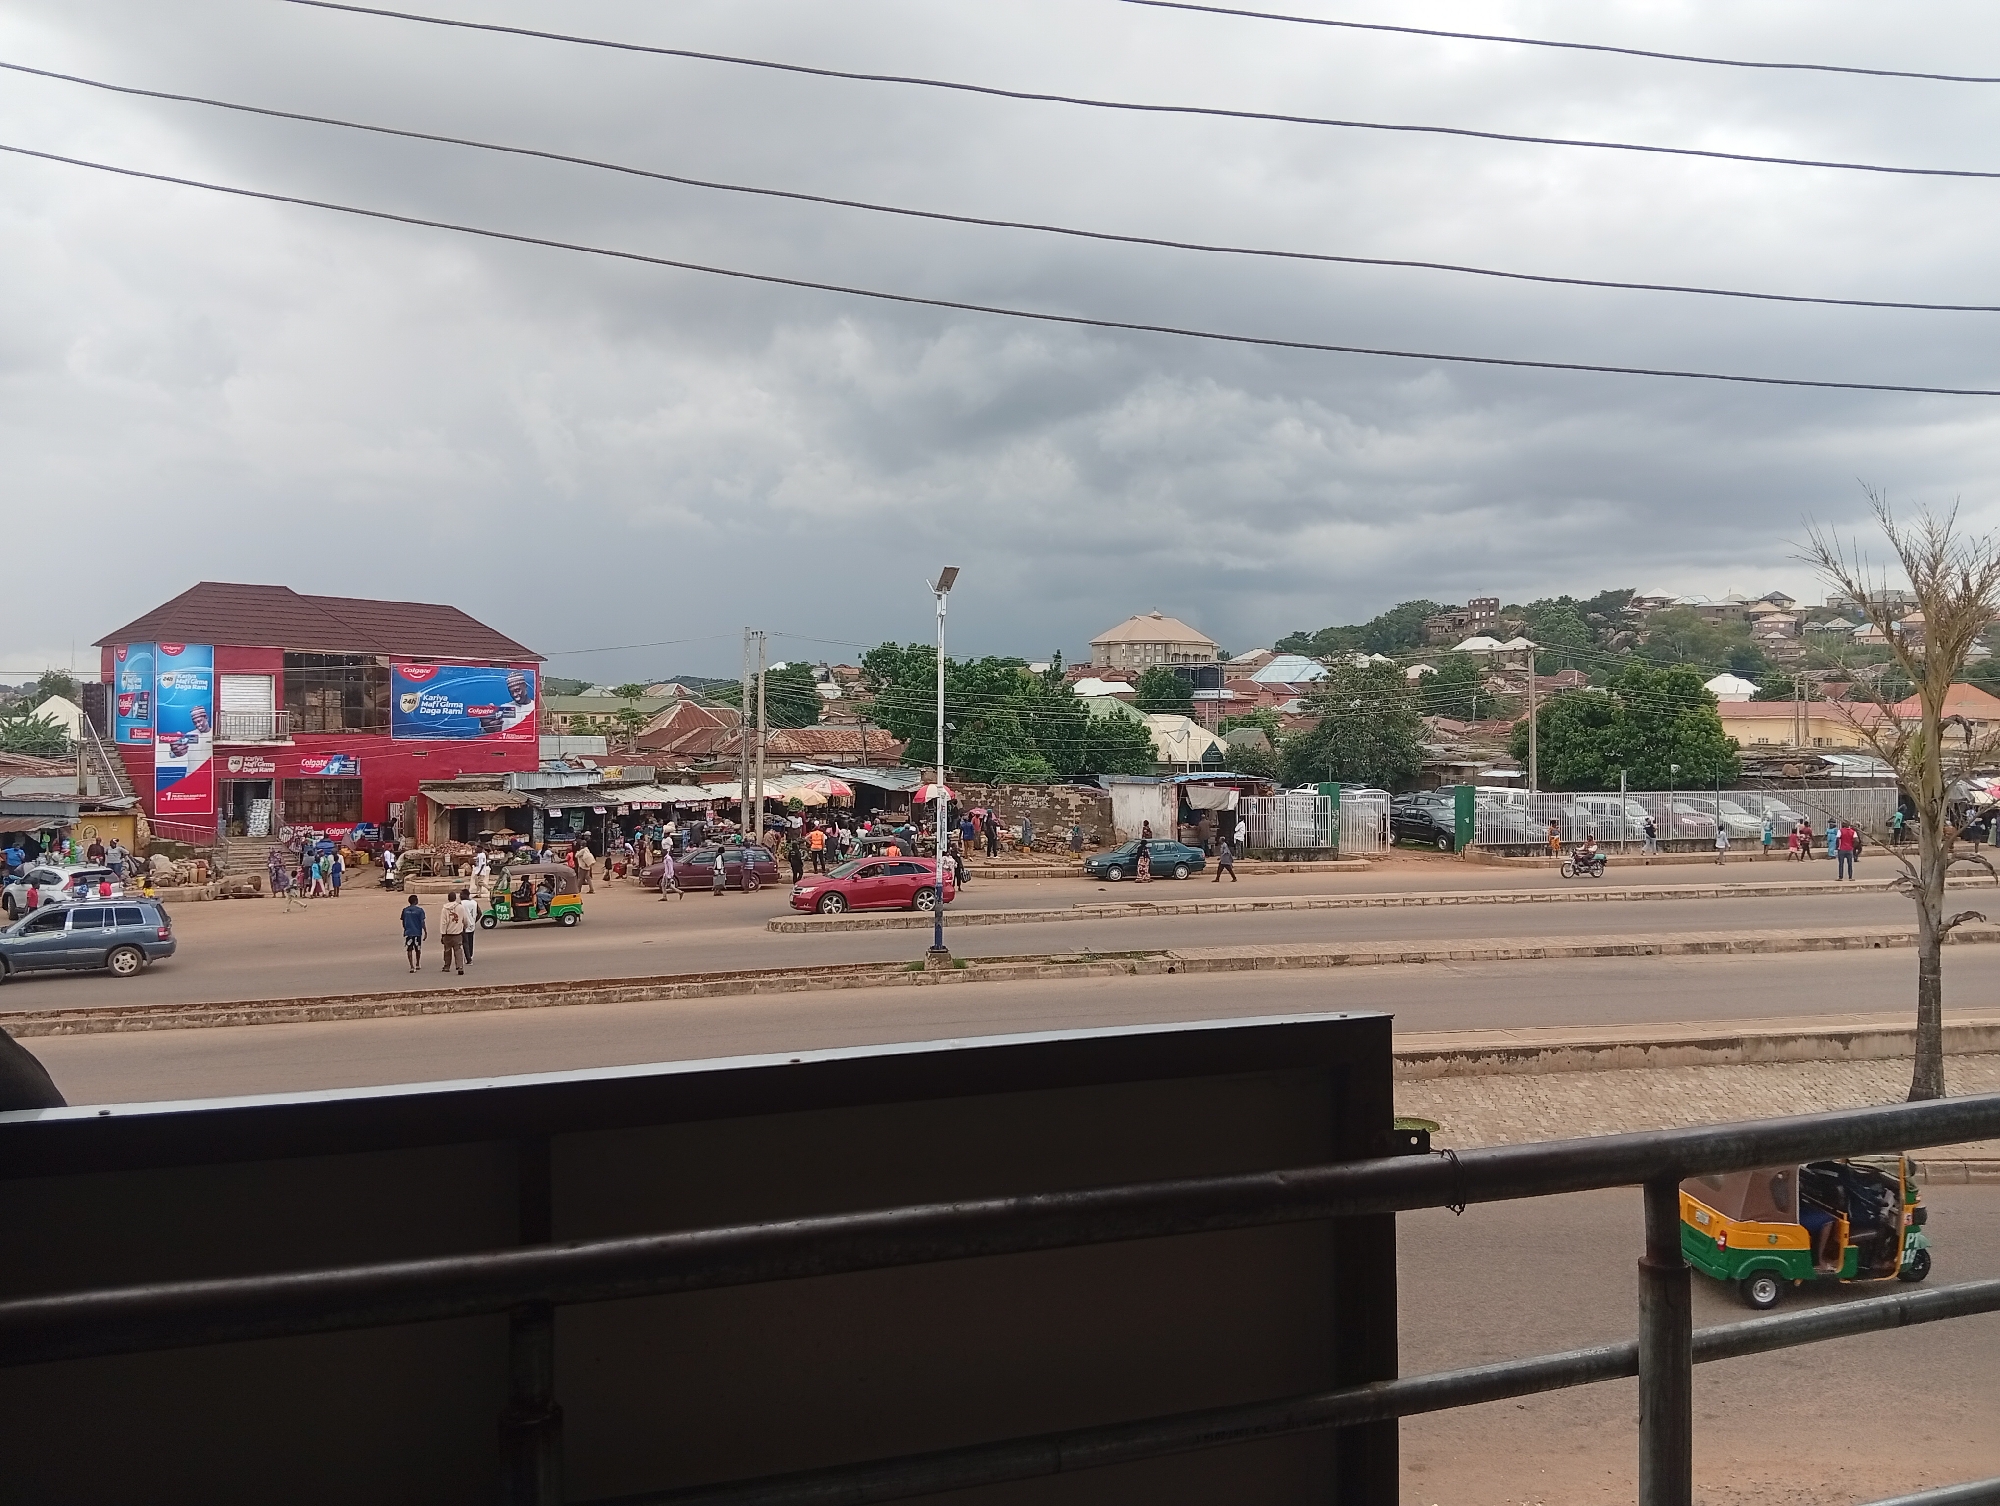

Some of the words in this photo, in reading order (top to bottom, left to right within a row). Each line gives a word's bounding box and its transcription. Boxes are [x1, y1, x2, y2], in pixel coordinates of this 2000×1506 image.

[420, 707, 441, 716] Daga
[468, 707, 494, 715] Colgate
[301, 758, 328, 768] Colgate
[326, 827, 352, 836] Colgate
